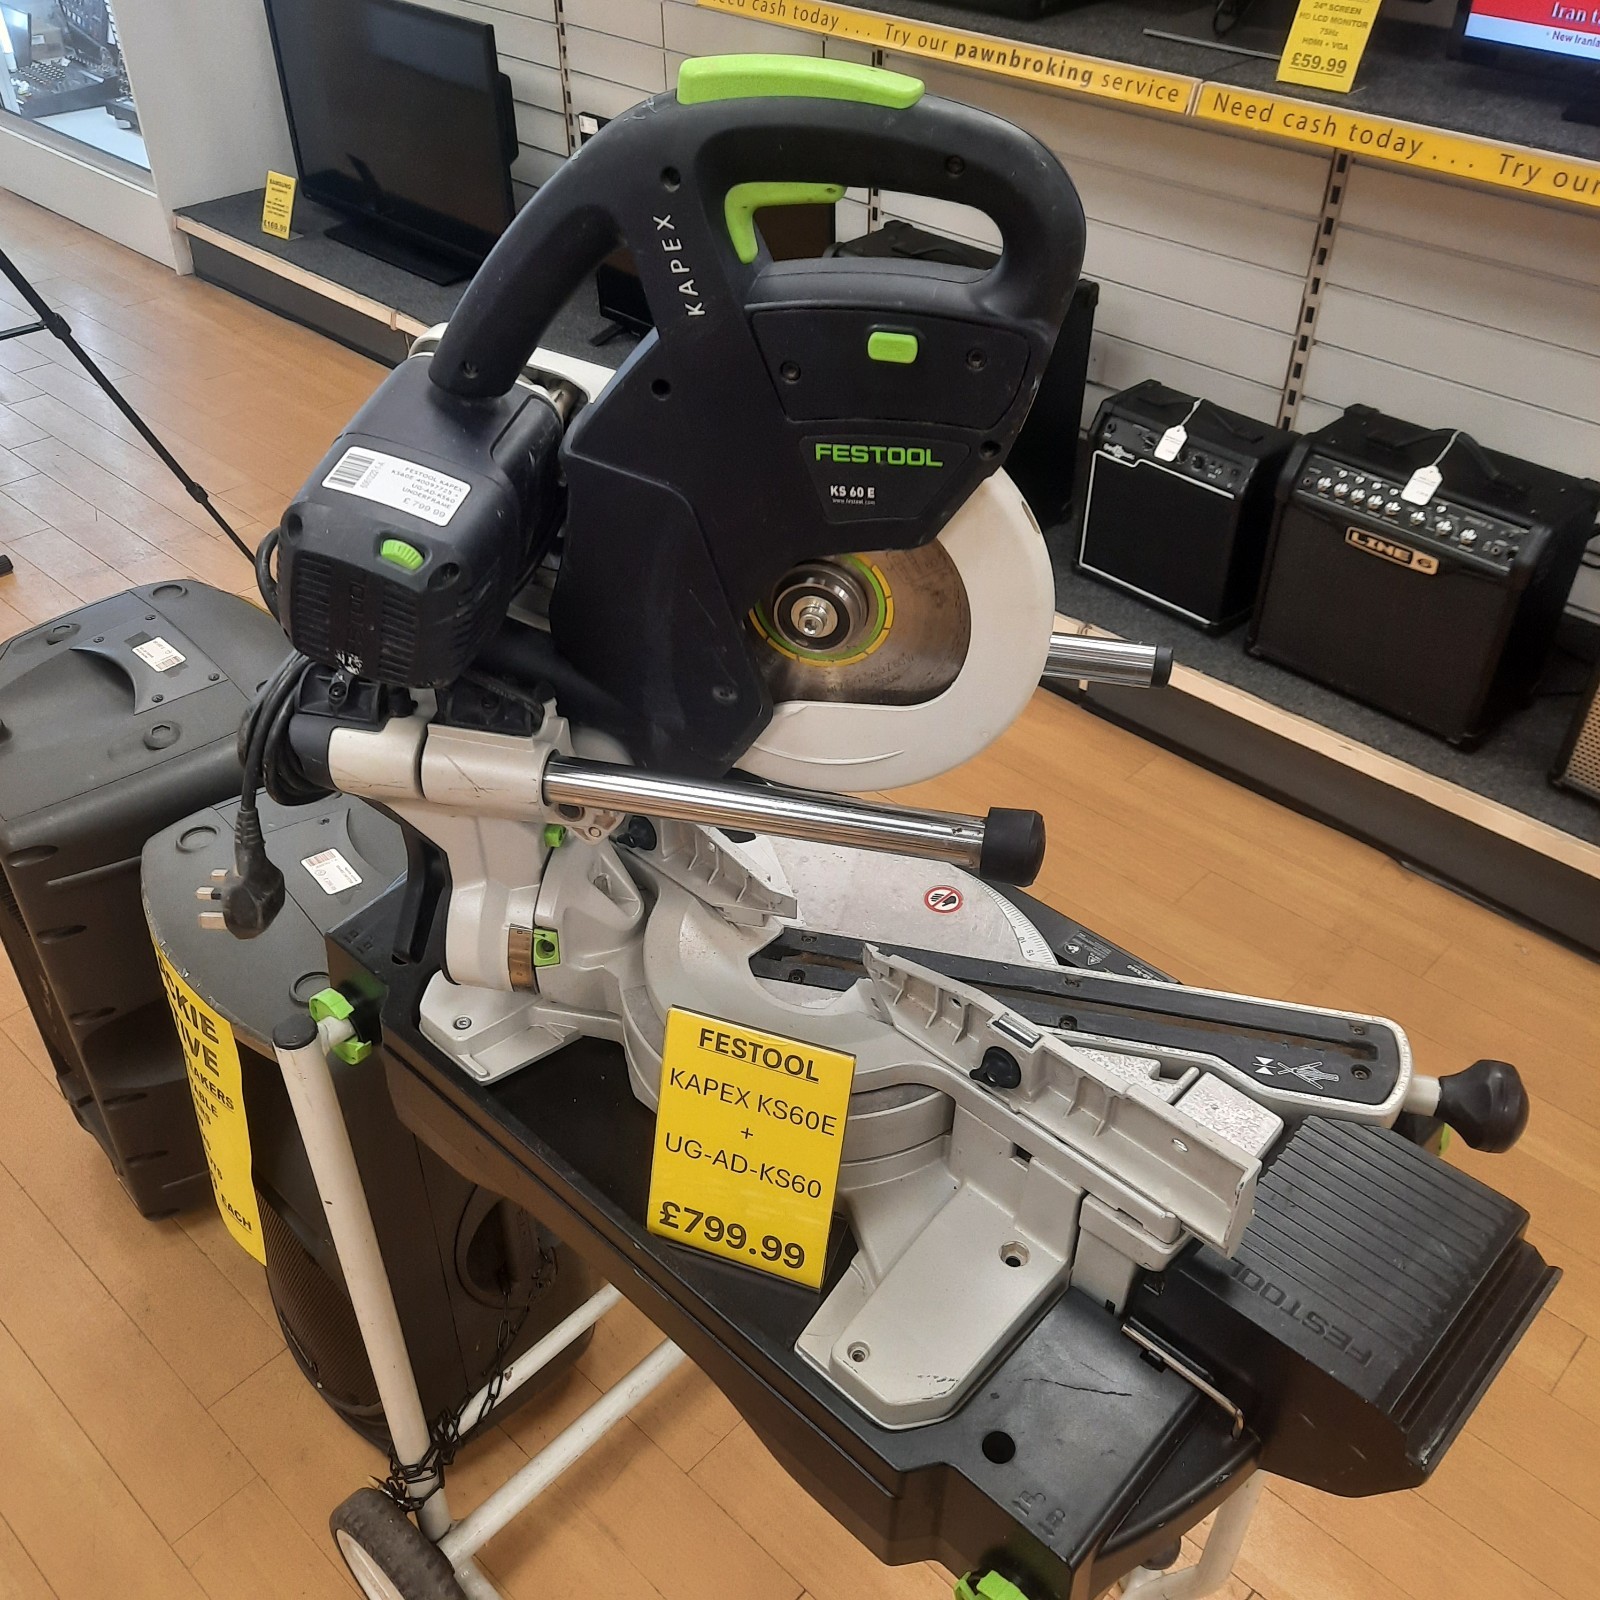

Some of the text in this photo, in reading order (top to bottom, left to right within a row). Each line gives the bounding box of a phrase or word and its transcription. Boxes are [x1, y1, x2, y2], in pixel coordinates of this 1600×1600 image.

[1329, 4, 1362, 15] SCREEN
[1551, 1, 1587, 23] Iran
[1313, 15, 1328, 23] LCD
[1330, 16, 1369, 29] MONITOR
[1301, 37, 1323, 47] HDMI
[1332, 41, 1349, 51] VGA
[1551, 30, 1574, 42] New
[752, 0, 786, 16] cash
[793, 8, 839, 32] today
[885, 23, 911, 47] Try
[918, 35, 949, 53] our
[955, 43, 1093, 87] pawnbroking
[1101, 73, 1180, 104] service
[1291, 52, 1347, 74] £59.99
[1213, 92, 1275, 124] Need
[1283, 112, 1337, 137] cash
[1349, 123, 1423, 159] today
[1499, 153, 1541, 186] Try
[652, 213, 706, 317] KAPEX
[815, 443, 944, 467] FESTOOL
[404, 467, 437, 483] FESTOOL
[402, 487, 451, 509] UNDERFRAME
[830, 485, 875, 499] KS 60 E
[1351, 531, 1432, 568] LINE 6
[699, 1027, 820, 1083] FESTOOL
[670, 1068, 838, 1137] KAPEX KS60E
[740, 1127, 754, 1140] +
[666, 1132, 822, 1199] UG-AD-KS60
[221, 1194, 253, 1231] EACH
[659, 1201, 806, 1269] £799.99
[1231, 1257, 1373, 1366] FESTOOL
